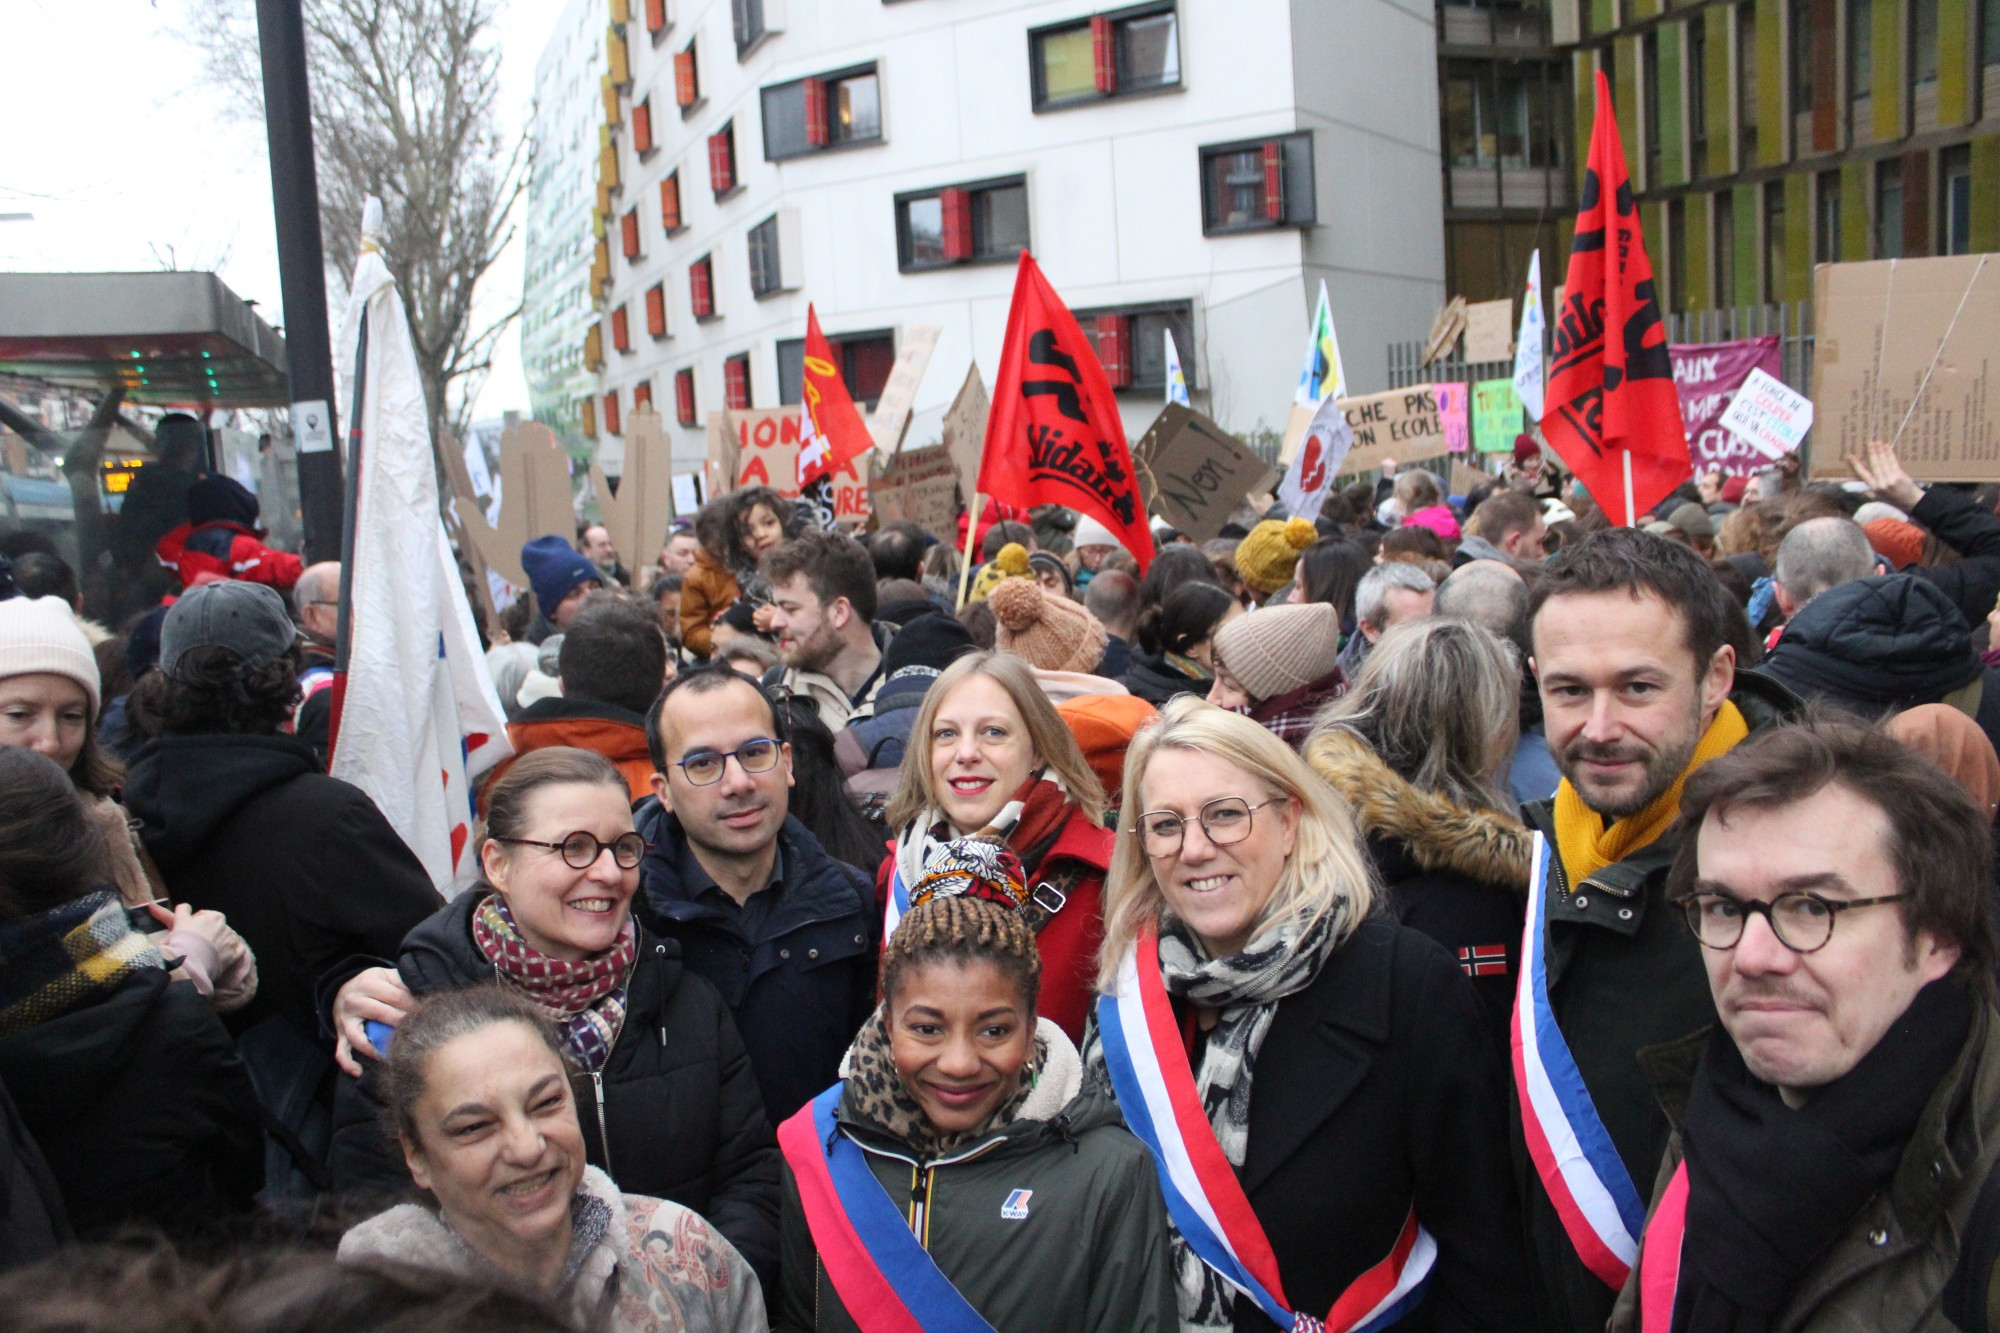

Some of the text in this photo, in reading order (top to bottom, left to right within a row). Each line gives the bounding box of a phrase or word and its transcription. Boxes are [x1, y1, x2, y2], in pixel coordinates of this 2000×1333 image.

[1345, 390, 1438, 428] CHE PAS
[1350, 428, 1376, 449] ON
[1390, 416, 1443, 442] ECOLE
[1161, 458, 1236, 522] Non
